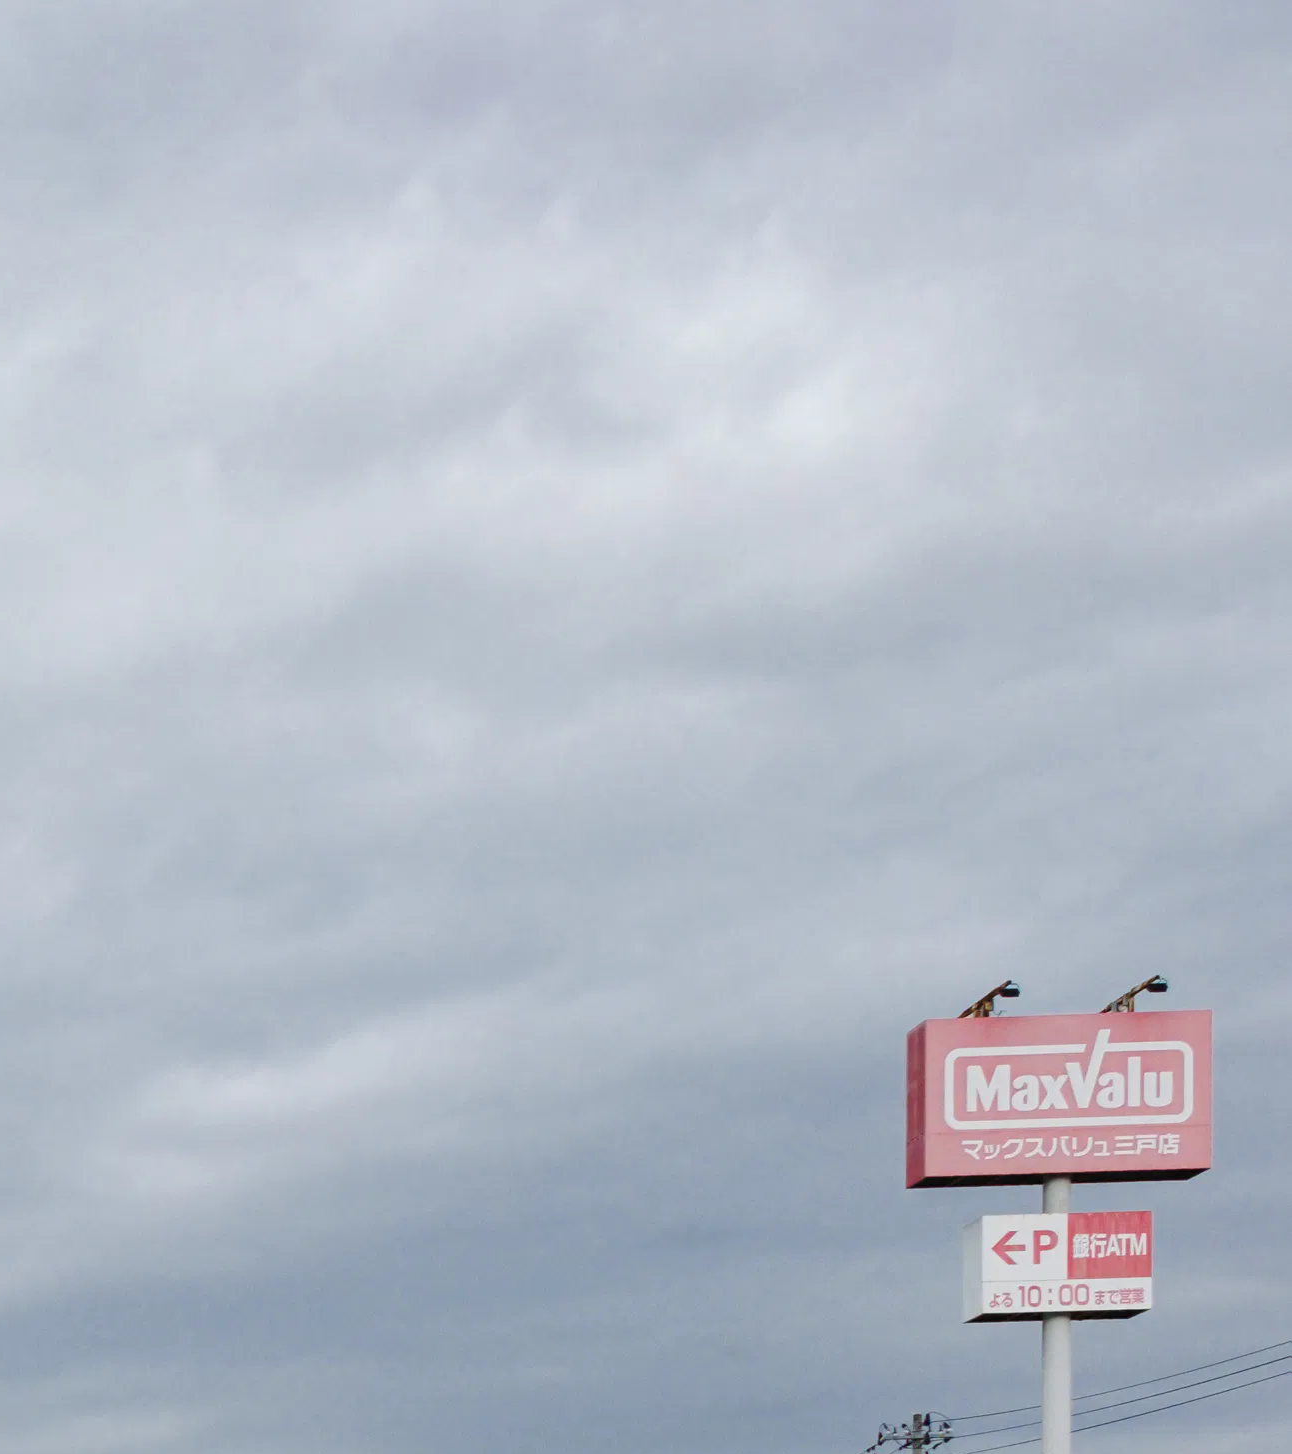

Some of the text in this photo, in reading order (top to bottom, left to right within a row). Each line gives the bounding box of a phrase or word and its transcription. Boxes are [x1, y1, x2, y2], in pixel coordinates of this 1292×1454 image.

[965, 1028, 1174, 1113] MaxValu
[961, 1133, 1180, 1160] マックスバリュ三戸店
[1032, 1230, 1059, 1264] P
[1072, 1233, 1147, 1259] 銀行ATM
